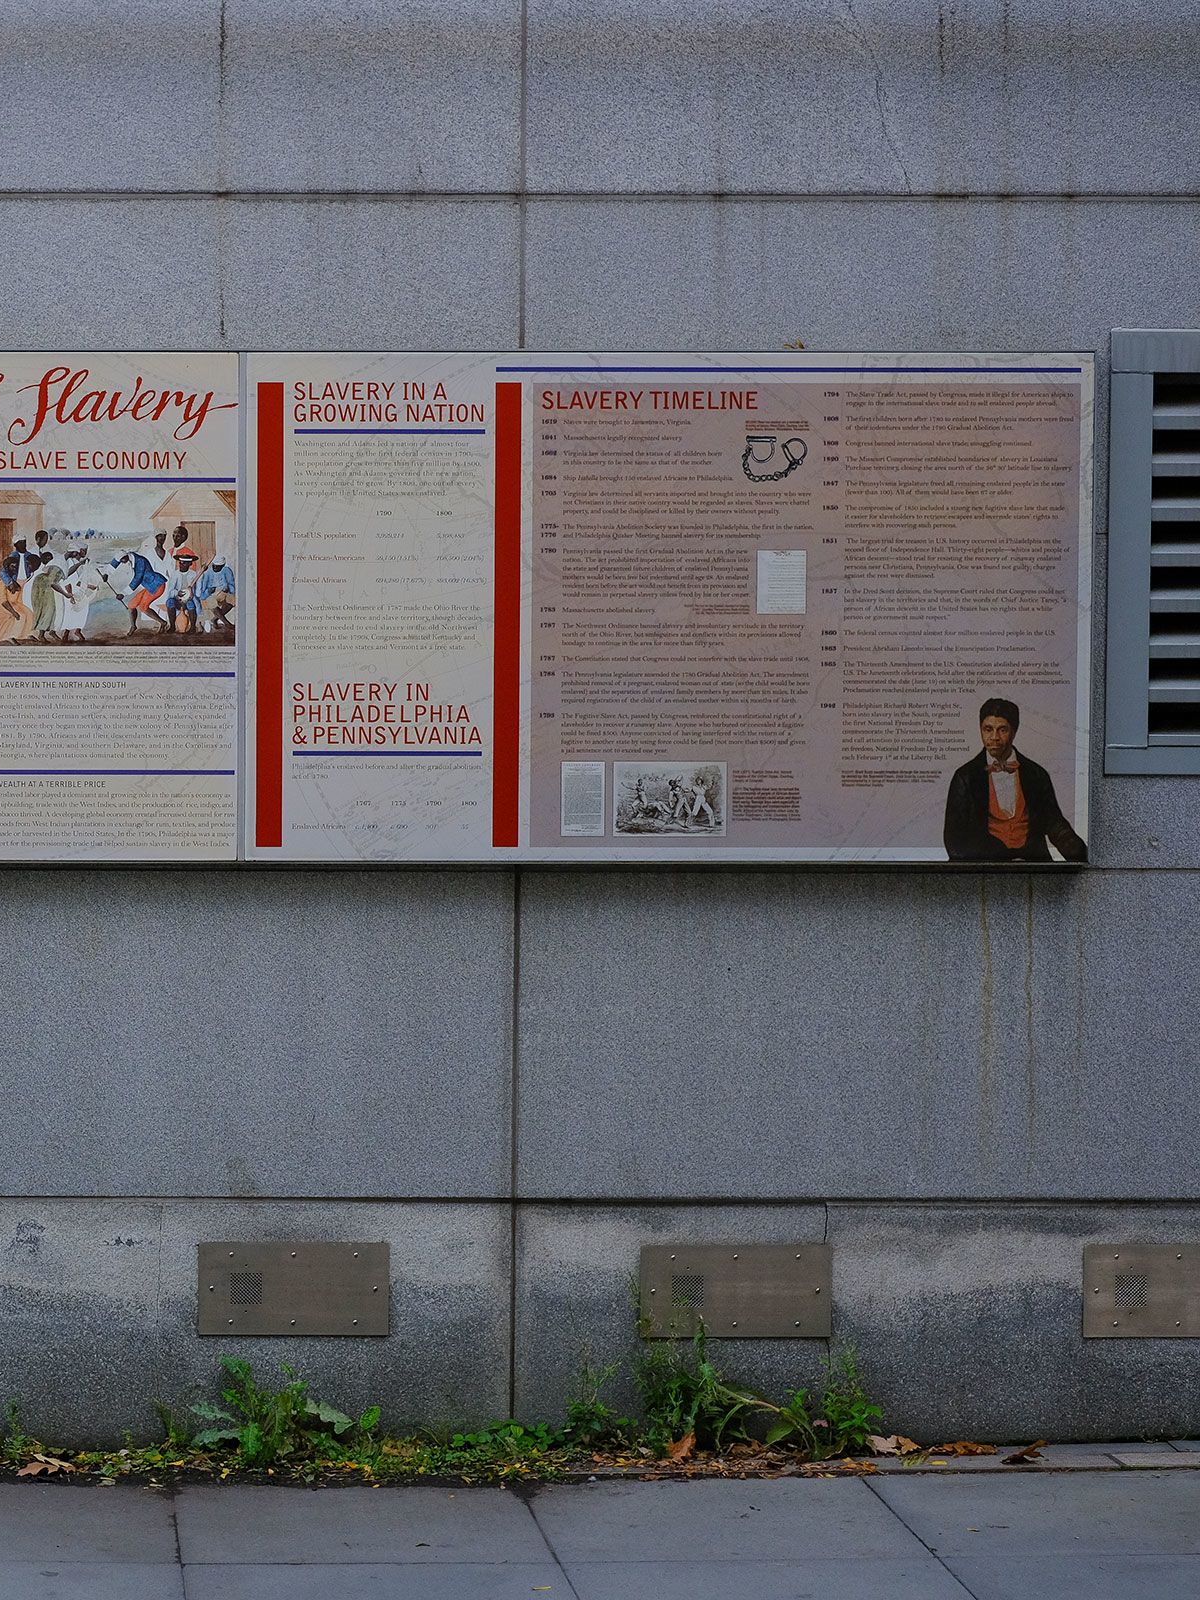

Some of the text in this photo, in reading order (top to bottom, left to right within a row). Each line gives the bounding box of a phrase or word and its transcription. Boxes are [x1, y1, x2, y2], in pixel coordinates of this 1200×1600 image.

[294, 382, 447, 400] SLAVERY IN A
[542, 391, 757, 409] SLAVERY TIMELINE
[8, 367, 239, 446] Slavery
[294, 404, 484, 422] GROWING NATION
[78, 451, 187, 469] ECONOMY
[293, 683, 428, 701] SLAVERY IN
[293, 705, 469, 722] PHILADELPHIA
[293, 726, 481, 744] & PENNSYLVANIA
